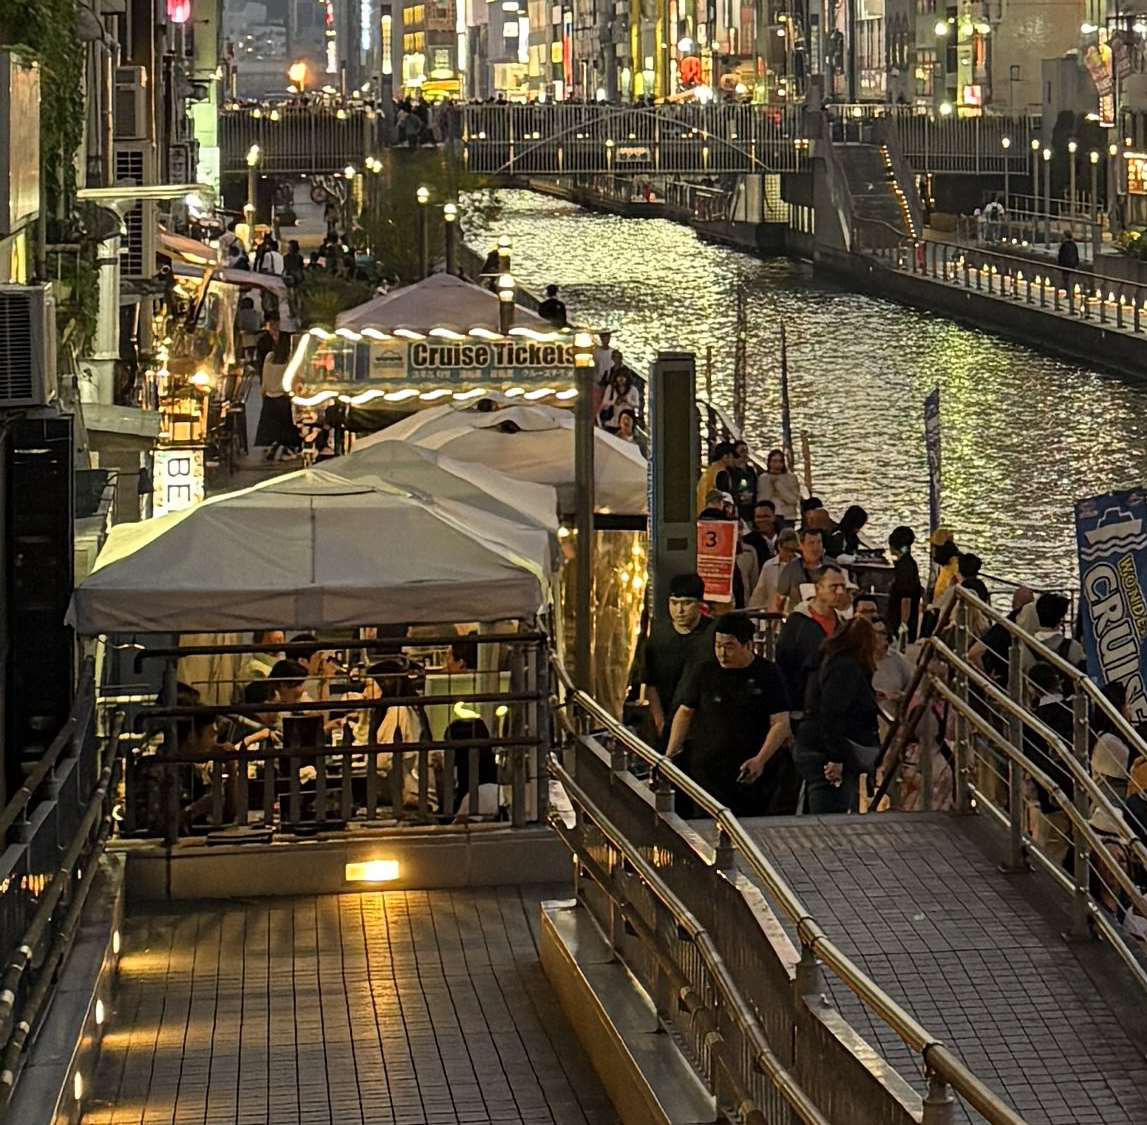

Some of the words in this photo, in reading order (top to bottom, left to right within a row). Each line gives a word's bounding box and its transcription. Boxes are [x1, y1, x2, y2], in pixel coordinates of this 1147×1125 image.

[413, 342, 489, 366] Cruise
[492, 342, 574, 366] Tickets
[168, 457, 191, 513] BE
[706, 531, 718, 548] 3
